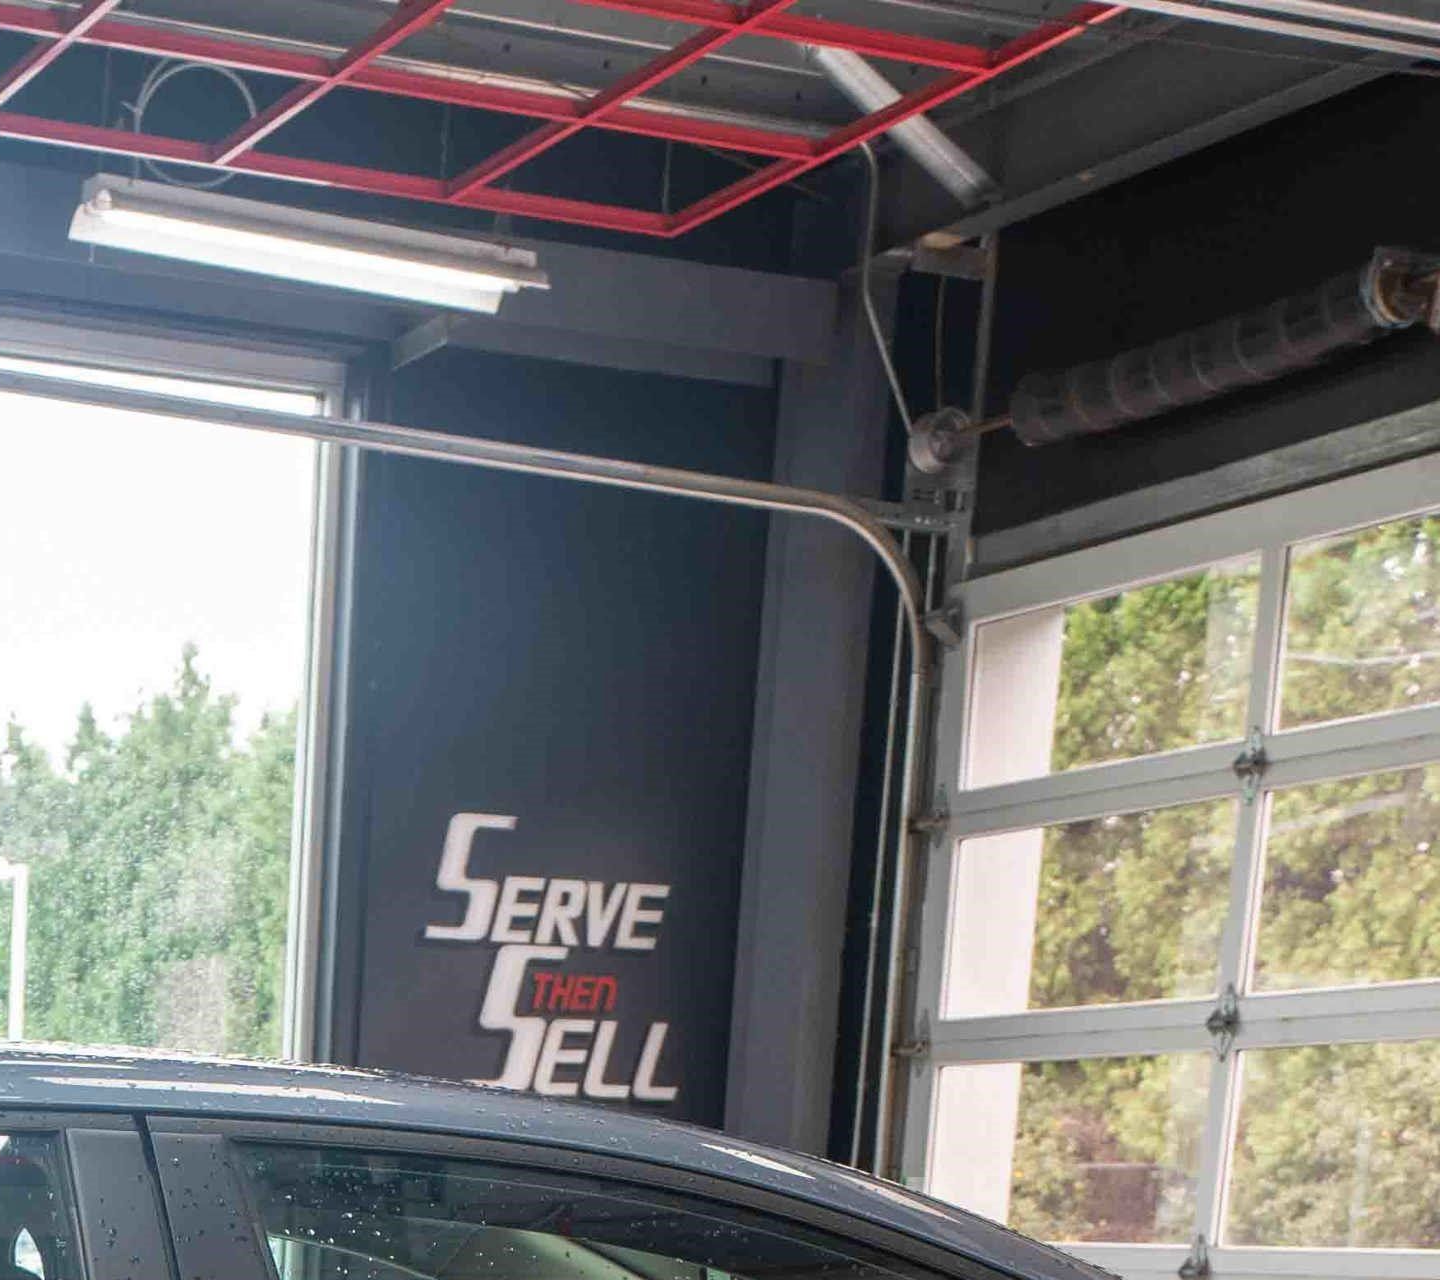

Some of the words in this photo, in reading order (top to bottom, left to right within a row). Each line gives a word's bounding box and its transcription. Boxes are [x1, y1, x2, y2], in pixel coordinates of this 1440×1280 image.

[424, 811, 672, 950] SERVE
[466, 944, 679, 1101] SELL
[531, 971, 618, 1012] THEN
